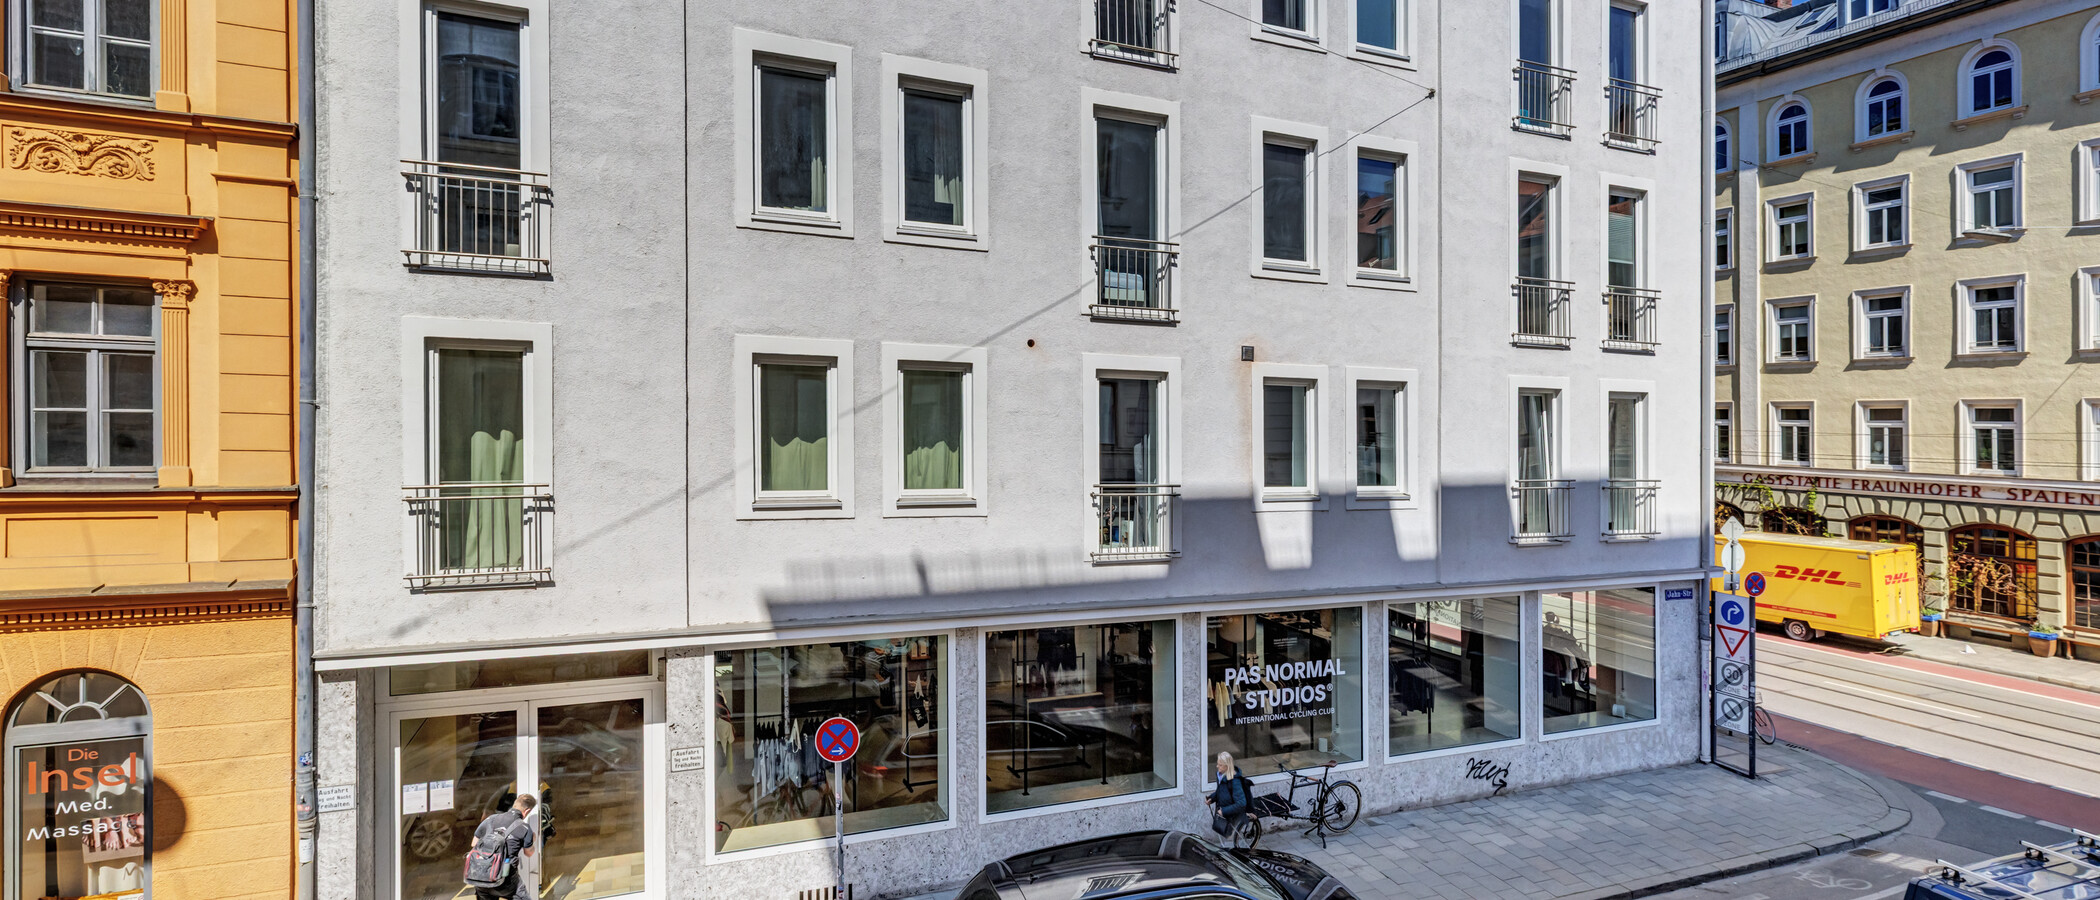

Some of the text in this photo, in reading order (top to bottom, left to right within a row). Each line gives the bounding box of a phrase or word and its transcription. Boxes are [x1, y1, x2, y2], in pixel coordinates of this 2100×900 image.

[1851, 479, 1982, 498] FRAUNHOFER
[2007, 487, 2095, 506] SPATEN
[1774, 564, 1847, 586] DHL
[1884, 572, 1910, 586] DHL
[1225, 658, 1346, 686] PAS NORMAL
[1725, 668, 1739, 680] 30
[1724, 685, 1741, 694] ZONE
[1235, 707, 1335, 725] INTERNATIONAL CYCLING CLUB
[1724, 721, 1741, 730] ZONE
[68, 748, 99, 762] Die
[28, 752, 137, 795] Insel
[319, 788, 349, 796] Ausfahrt
[55, 797, 113, 815] Med.
[318, 802, 351, 810] reihalten
[26, 819, 138, 841] Massage
